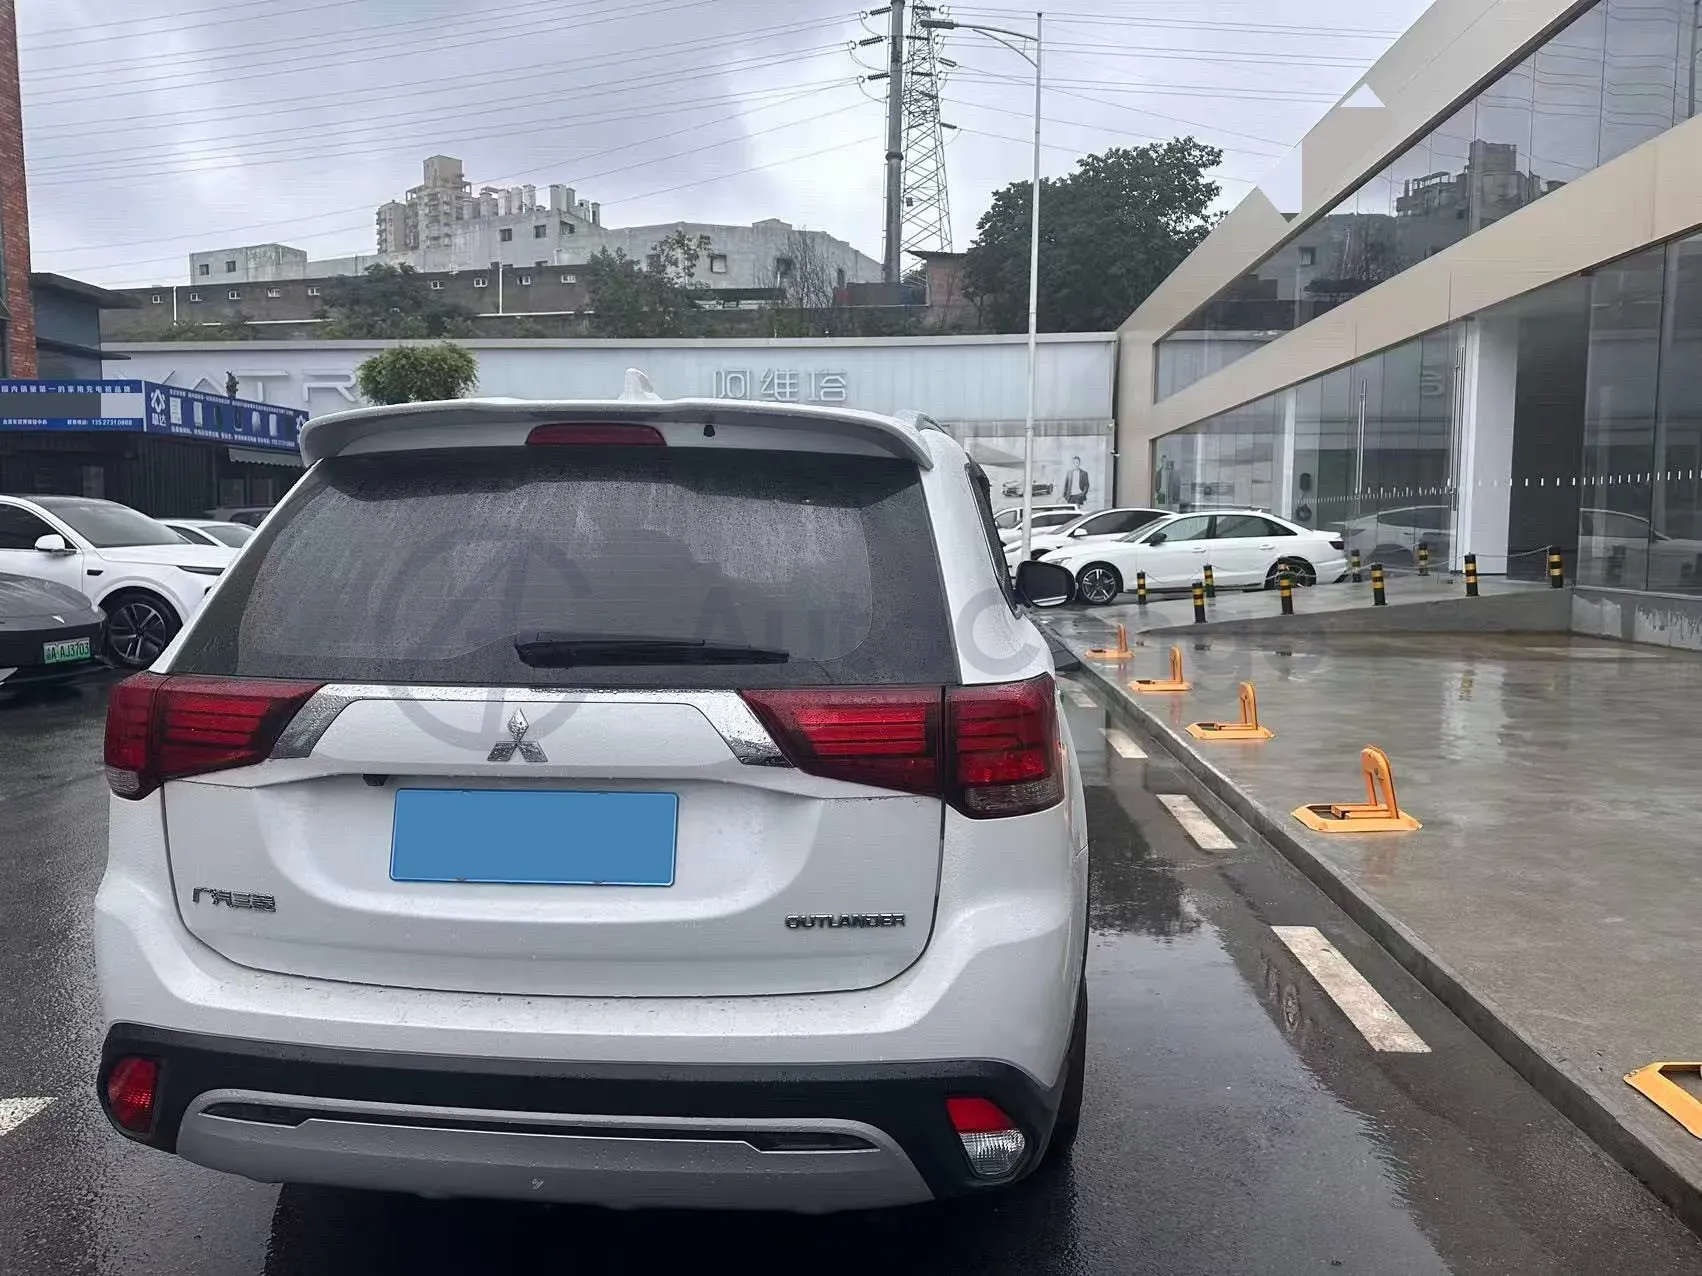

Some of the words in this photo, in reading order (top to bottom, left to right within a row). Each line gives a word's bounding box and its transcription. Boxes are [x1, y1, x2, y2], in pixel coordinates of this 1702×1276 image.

[712, 367, 847, 401] 阿维塔
[785, 912, 906, 929] OUTLANDER
